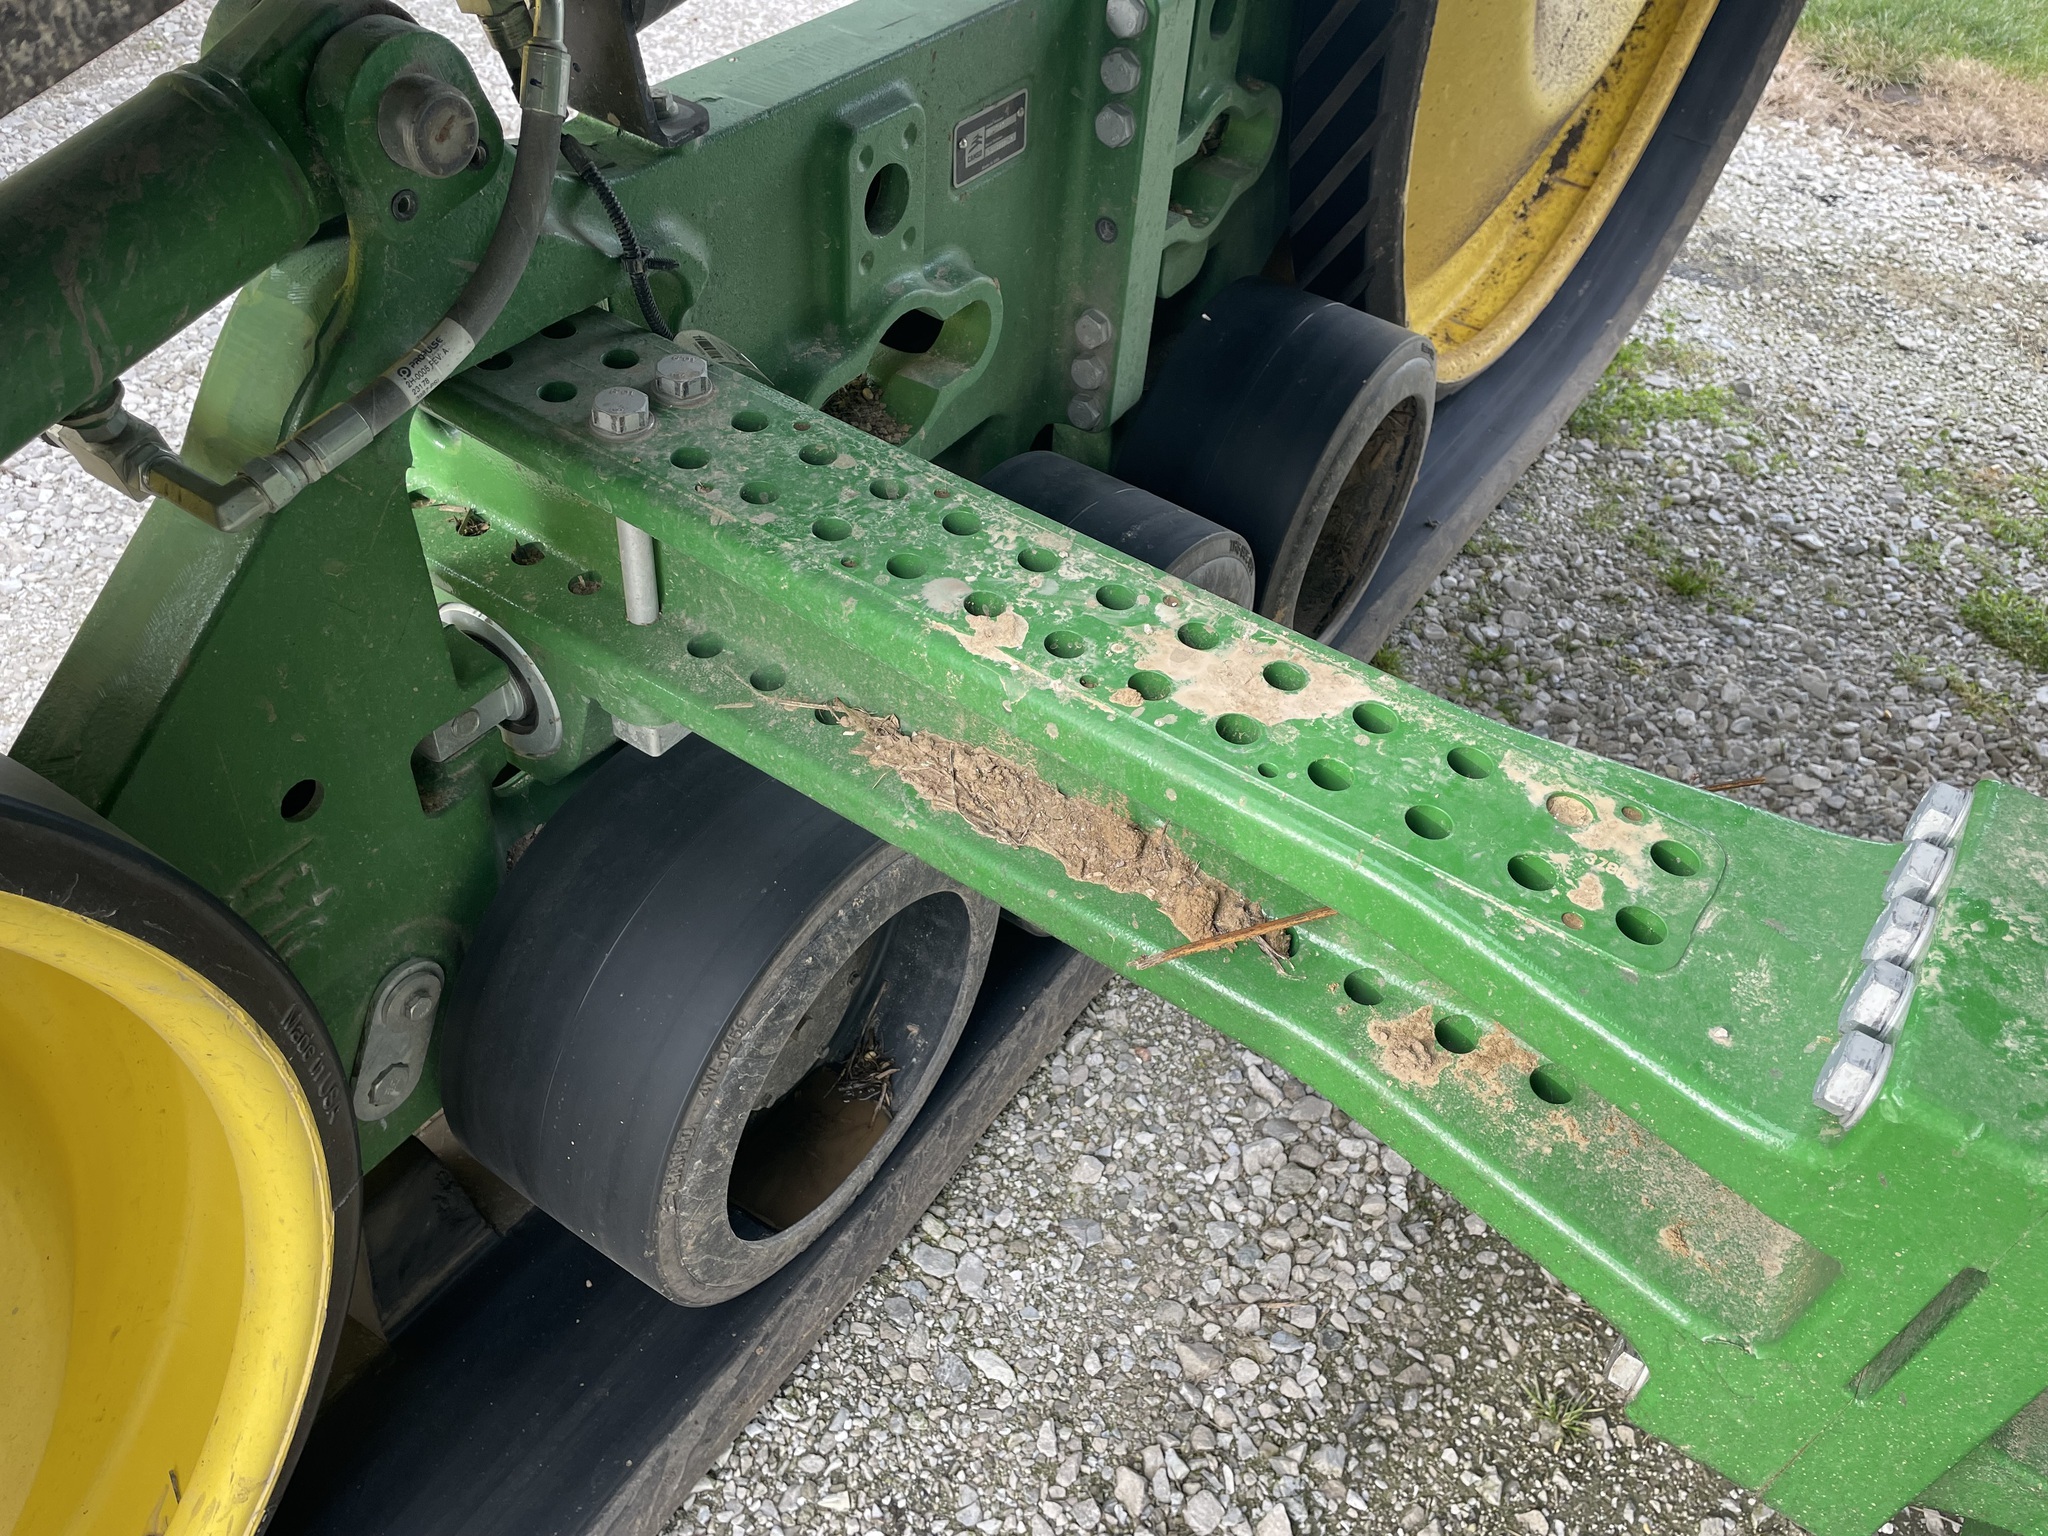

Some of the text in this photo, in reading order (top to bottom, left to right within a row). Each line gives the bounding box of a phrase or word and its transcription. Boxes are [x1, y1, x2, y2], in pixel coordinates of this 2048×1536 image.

[411, 377, 431, 395] 23178
[280, 1003, 341, 1126] Made in USA
